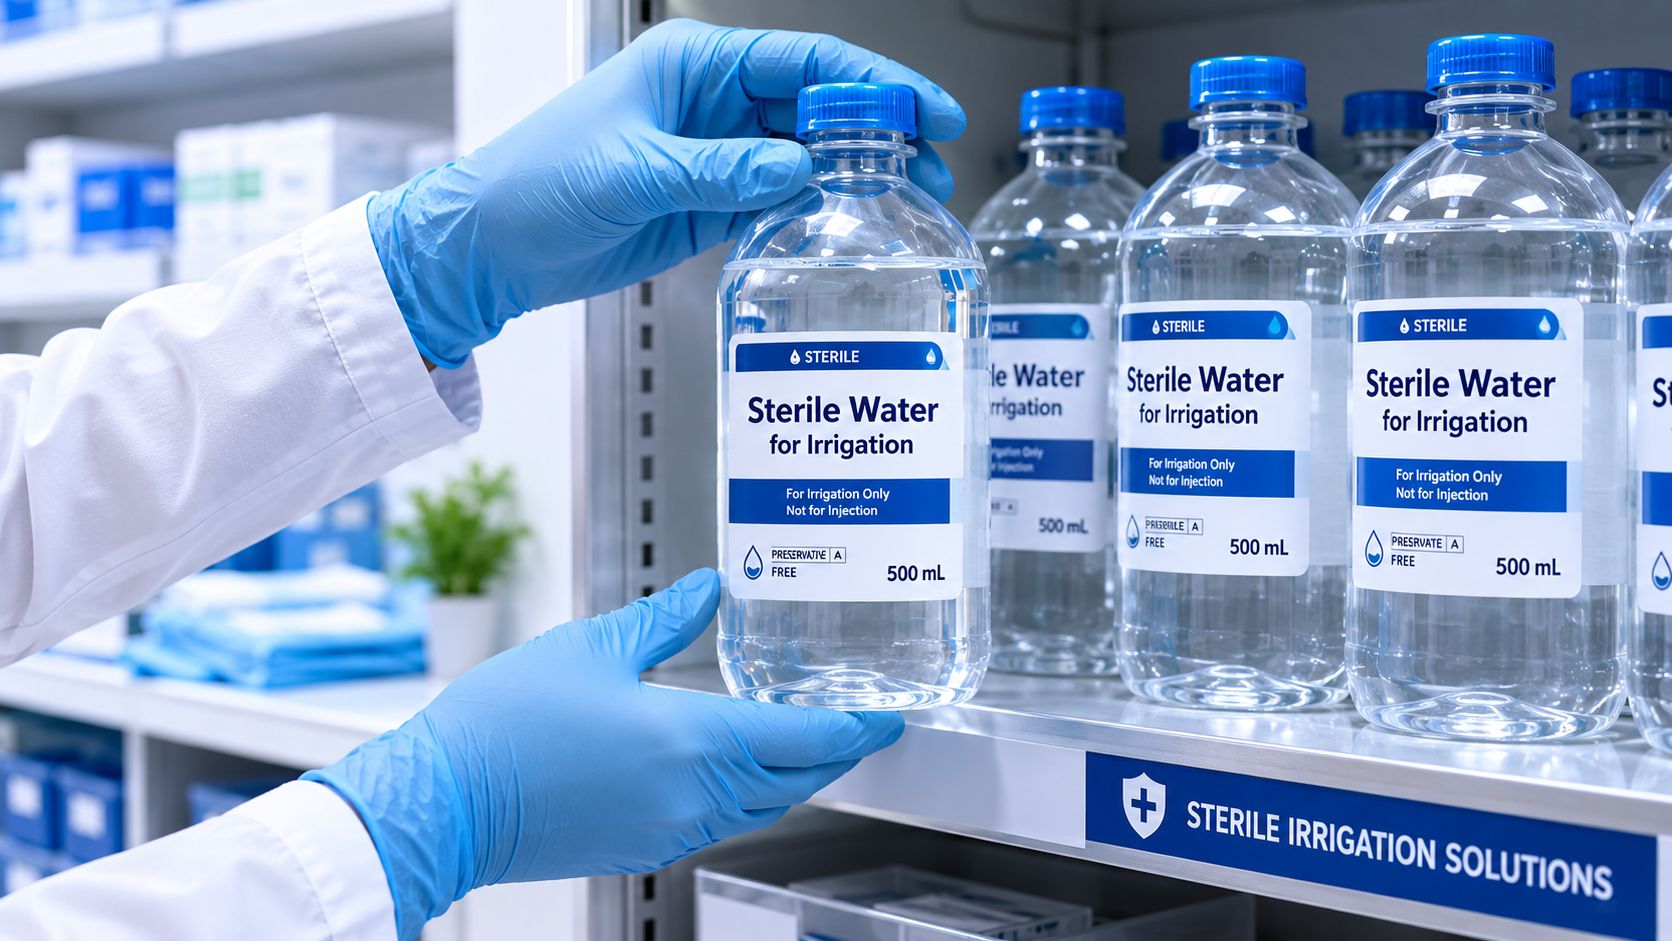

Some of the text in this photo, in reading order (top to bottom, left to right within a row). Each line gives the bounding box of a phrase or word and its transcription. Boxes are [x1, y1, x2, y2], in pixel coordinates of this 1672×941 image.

[1162, 319, 1206, 333] STERILE
[1413, 318, 1467, 333] STERILE
[804, 350, 860, 364] STERILE
[1013, 363, 1085, 388] Water
[1127, 365, 1285, 393] Sterile Water
[1366, 367, 1557, 398] Sterile Water
[747, 395, 939, 424] Sterile Water
[991, 397, 1063, 421] rrigation
[1139, 403, 1259, 429] for Irrigation
[1382, 408, 1528, 438] for Irrigation
[769, 433, 914, 460] for Irrigation
[1148, 457, 1236, 473] For Irrigation Only
[1148, 474, 1224, 490] Not for Injection
[1396, 468, 1503, 486] For Irrigation Only
[786, 487, 890, 503] For Irrigation Only
[1396, 486, 1489, 504] Not for Injection
[786, 504, 878, 519] Not for Injection
[1039, 517, 1089, 534] 500 mL
[1191, 521, 1199, 531] A
[1145, 536, 1165, 549] FREE
[1229, 538, 1289, 556] 500 mL
[1450, 539, 1459, 549] A
[833, 550, 842, 560] A
[1391, 554, 1416, 567] FREE
[771, 566, 797, 578] FREE
[887, 564, 946, 582] 500 mL
[1495, 557, 1562, 576] 500 mL
[1186, 800, 1614, 901] STERILE IRRIGATION SOLUTIONS
